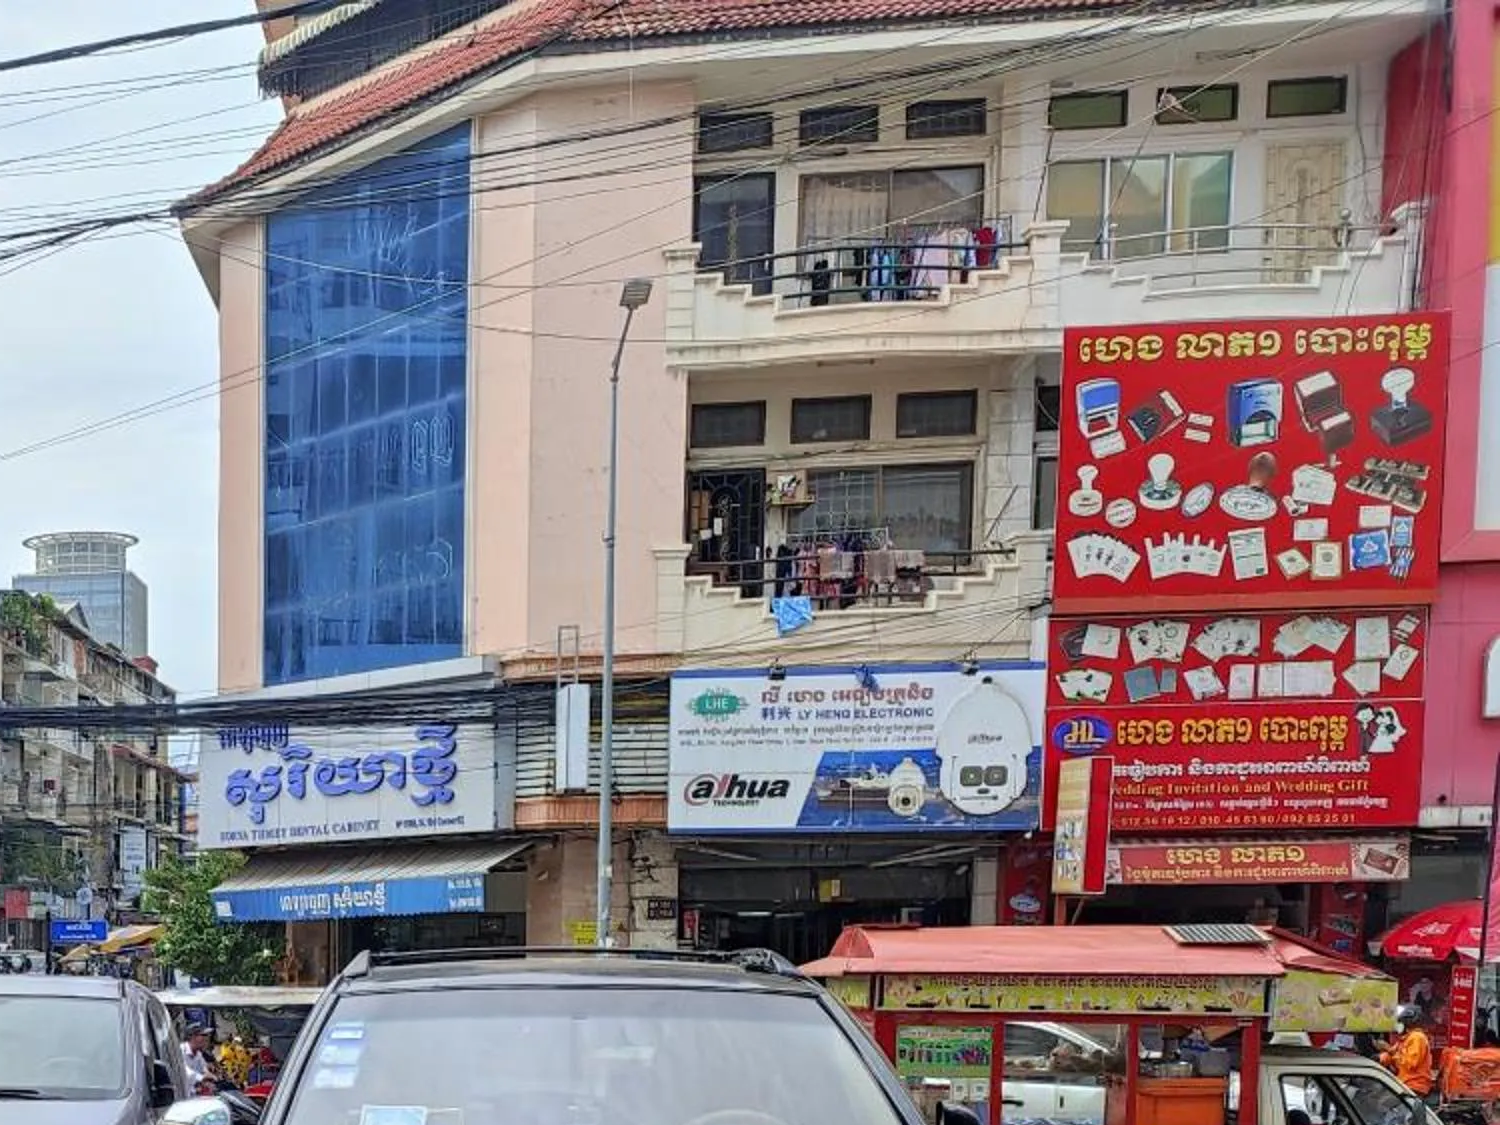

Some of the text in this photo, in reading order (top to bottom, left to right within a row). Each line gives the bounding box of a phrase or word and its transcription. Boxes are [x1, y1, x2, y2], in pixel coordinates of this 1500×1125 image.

[853, 707, 934, 719] ELECTRONIC
[1167, 781, 1240, 794] Invitation
[1244, 780, 1272, 793] and
[1276, 779, 1335, 795] Wedding
[1338, 779, 1369, 792] Gift
